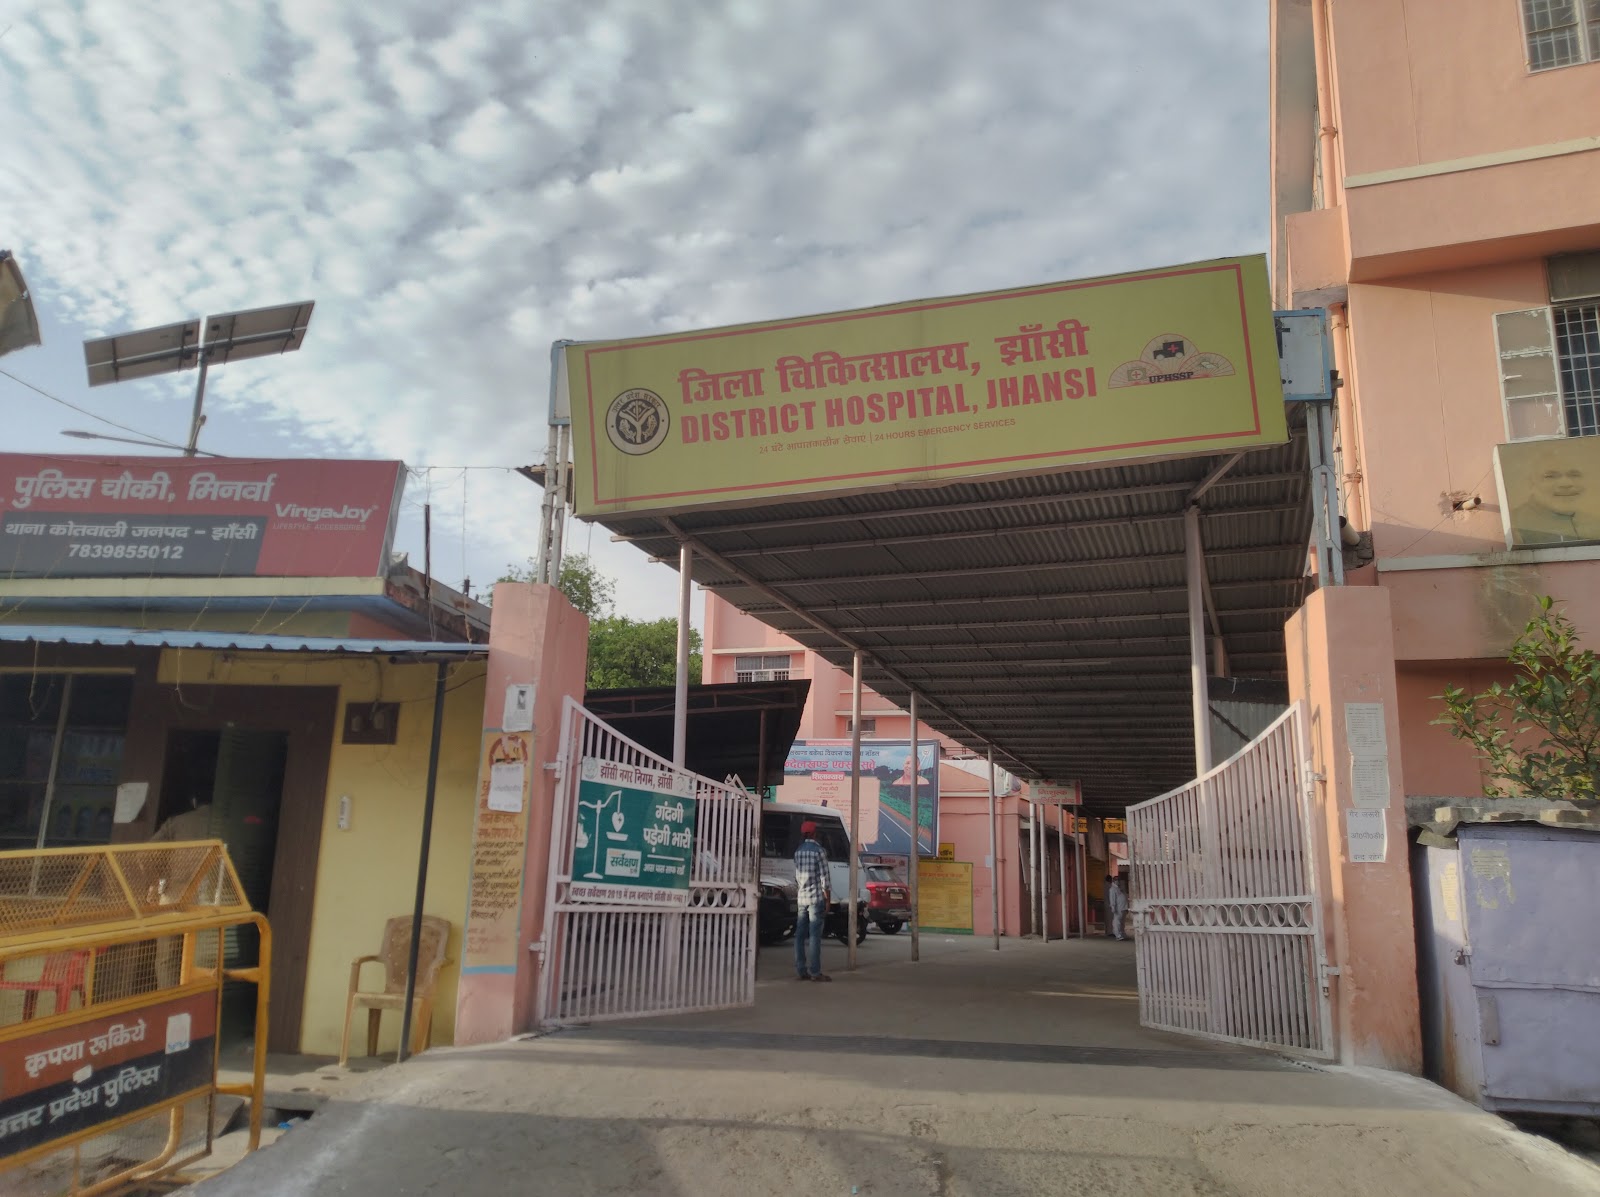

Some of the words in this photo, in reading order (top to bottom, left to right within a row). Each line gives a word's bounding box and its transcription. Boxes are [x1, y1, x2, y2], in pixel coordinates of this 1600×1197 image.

[677, 368, 764, 404] जिला
[775, 342, 981, 393] चिकित्सालय,
[1148, 371, 1194, 384] UPHSSP
[681, 402, 816, 444] DISTRICT
[825, 382, 979, 428] HOSPITAL,
[986, 367, 1097, 410] JHANSI
[874, 433, 884, 441] 24
[886, 430, 916, 441] HOURS
[918, 423, 971, 438] EMERGENCY
[973, 418, 1016, 430] SERVICES
[759, 445, 769, 454] 24
[12, 469, 96, 508] पुलिस
[188, 472, 279, 503] मिनर्वा
[5, 523, 47, 536] थाना
[49, 521, 128, 538] कोतवाली
[131, 525, 192, 539] जनपद
[68, 544, 184, 560] 7839855012
[619, 769, 633, 783] नगर
[655, 801, 684, 823] गंदगी
[643, 824, 671, 853] पड़ेगी
[671, 827, 692, 849] भारी
[610, 852, 639, 868] सर्वेक्षण
[607, 889, 622, 899] 2019
[24, 1040, 85, 1078] कृपया
[48, 1084, 101, 1123] प्रदेश
[101, 1065, 161, 1108] पुलिस
